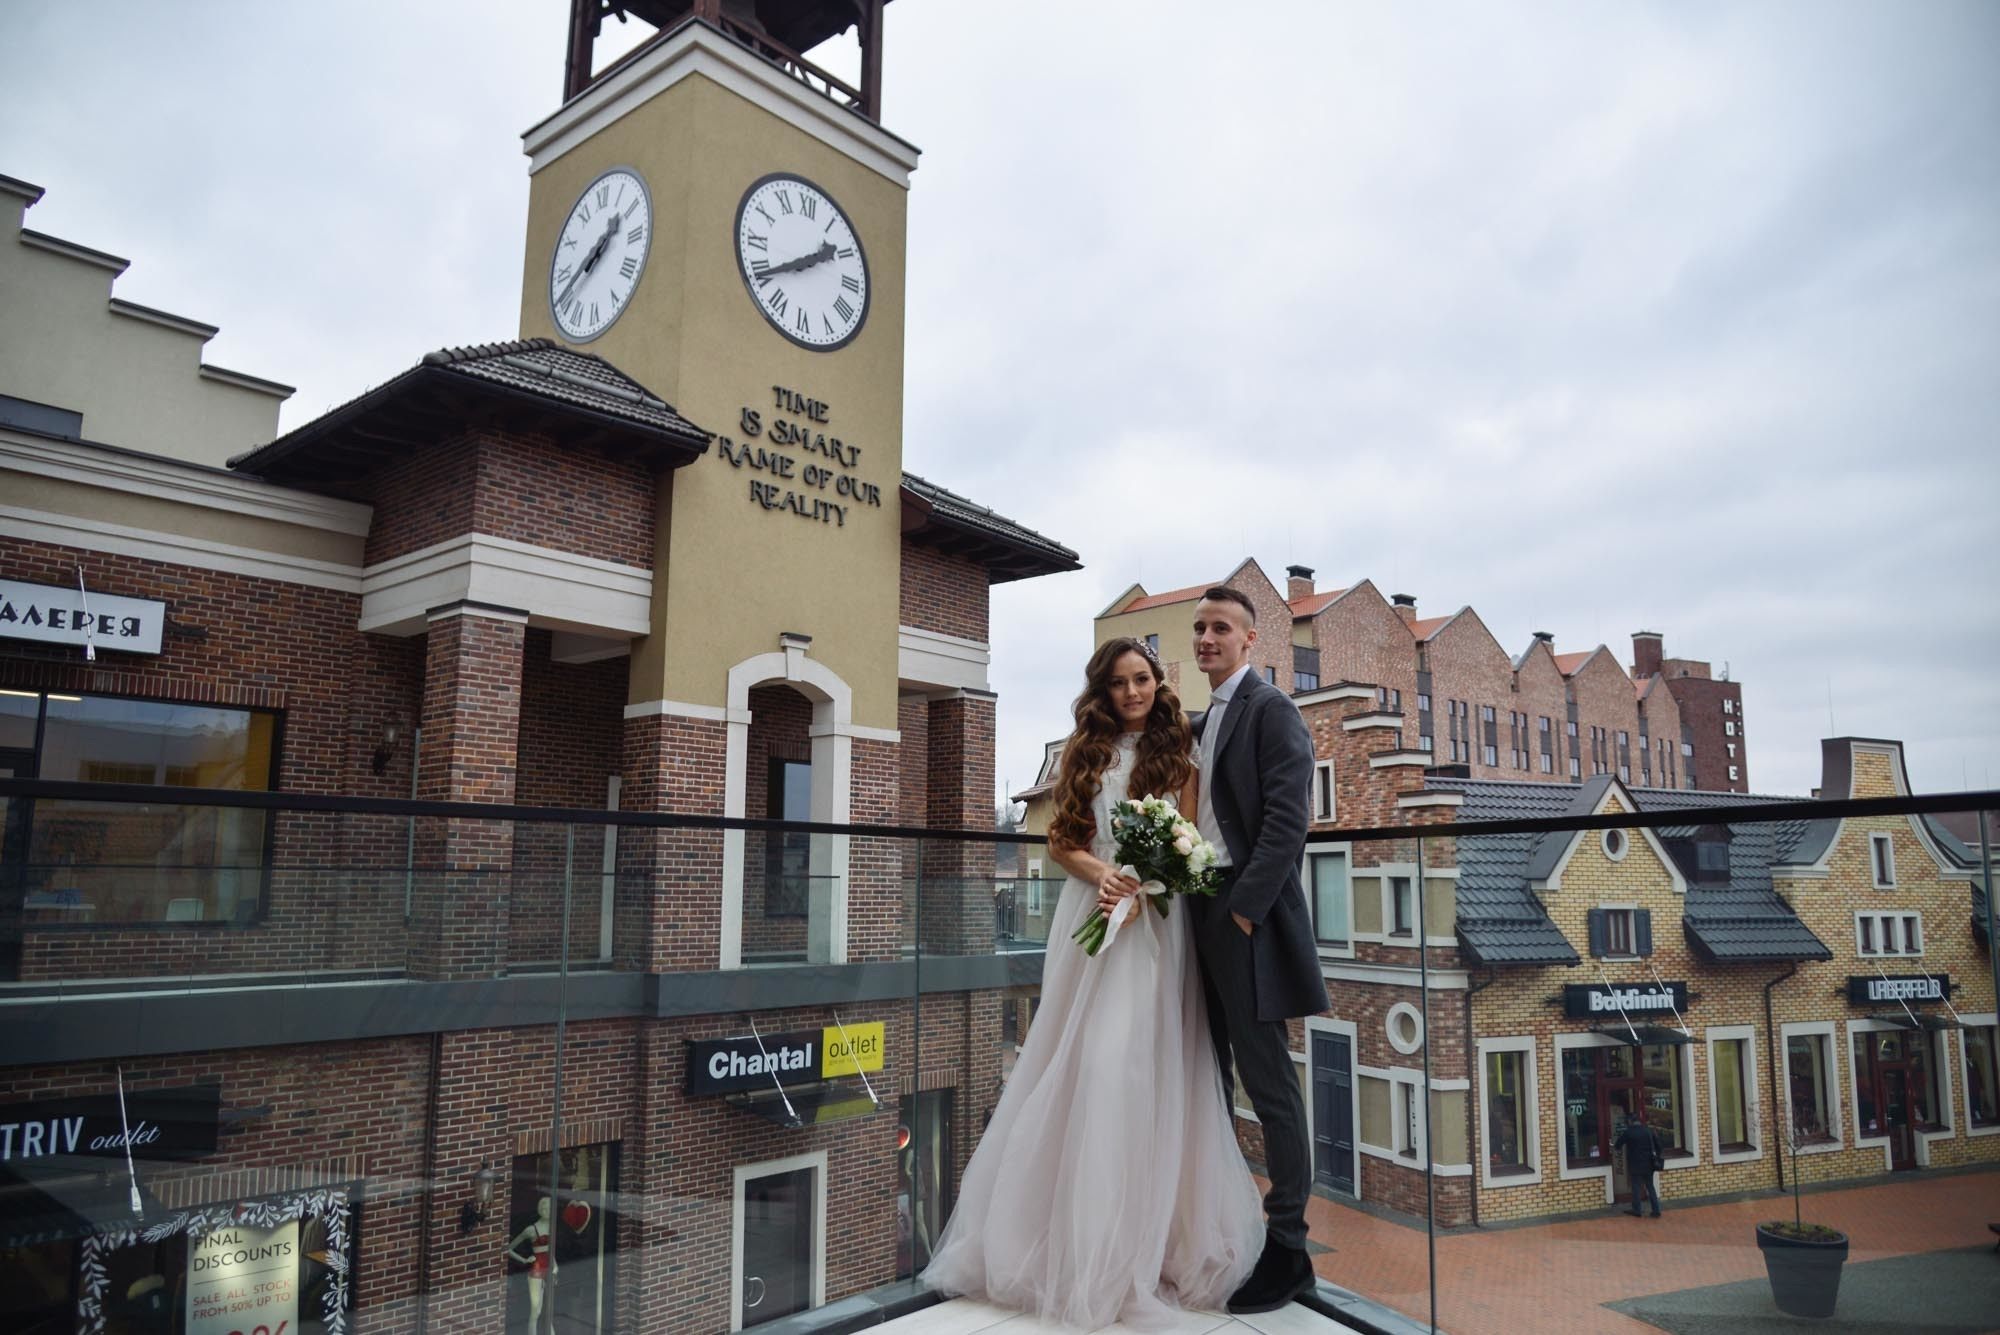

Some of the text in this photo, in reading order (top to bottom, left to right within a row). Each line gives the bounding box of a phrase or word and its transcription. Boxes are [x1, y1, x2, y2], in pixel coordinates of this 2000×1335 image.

[623, 197, 640, 220] II
[755, 201, 775, 228] X
[774, 189, 793, 215] XI
[799, 191, 817, 222] XII
[628, 224, 643, 245] III
[824, 217, 836, 234] I
[564, 235, 578, 251] X
[747, 228, 768, 252] IX
[836, 248, 854, 260] II
[841, 273, 859, 294] III
[796, 307, 810, 334] VI
[832, 295, 854, 324] IIII
[822, 311, 834, 336] V
[773, 385, 830, 424] TIME
[740, 407, 861, 468] IS SMART
[706, 432, 881, 508] RAME OF OUR
[750, 480, 848, 527] REALITY
[0, 594, 141, 637] АЛЕРЕЯ
[1723, 699, 1739, 792] HOTE
[1588, 988, 1674, 1011] Baldinini
[1868, 979, 1941, 1000] LAGERFELD
[708, 1035, 877, 1080] Chantal outlet
[0, 1117, 160, 1160] TRIV outlet
[194, 1231, 243, 1250] FINAL
[194, 1242, 291, 1271] DISCOUNTS
[193, 1292, 290, 1320] FROM 50% UP TO
[194, 1279, 290, 1307] SALE ALL STOCK
